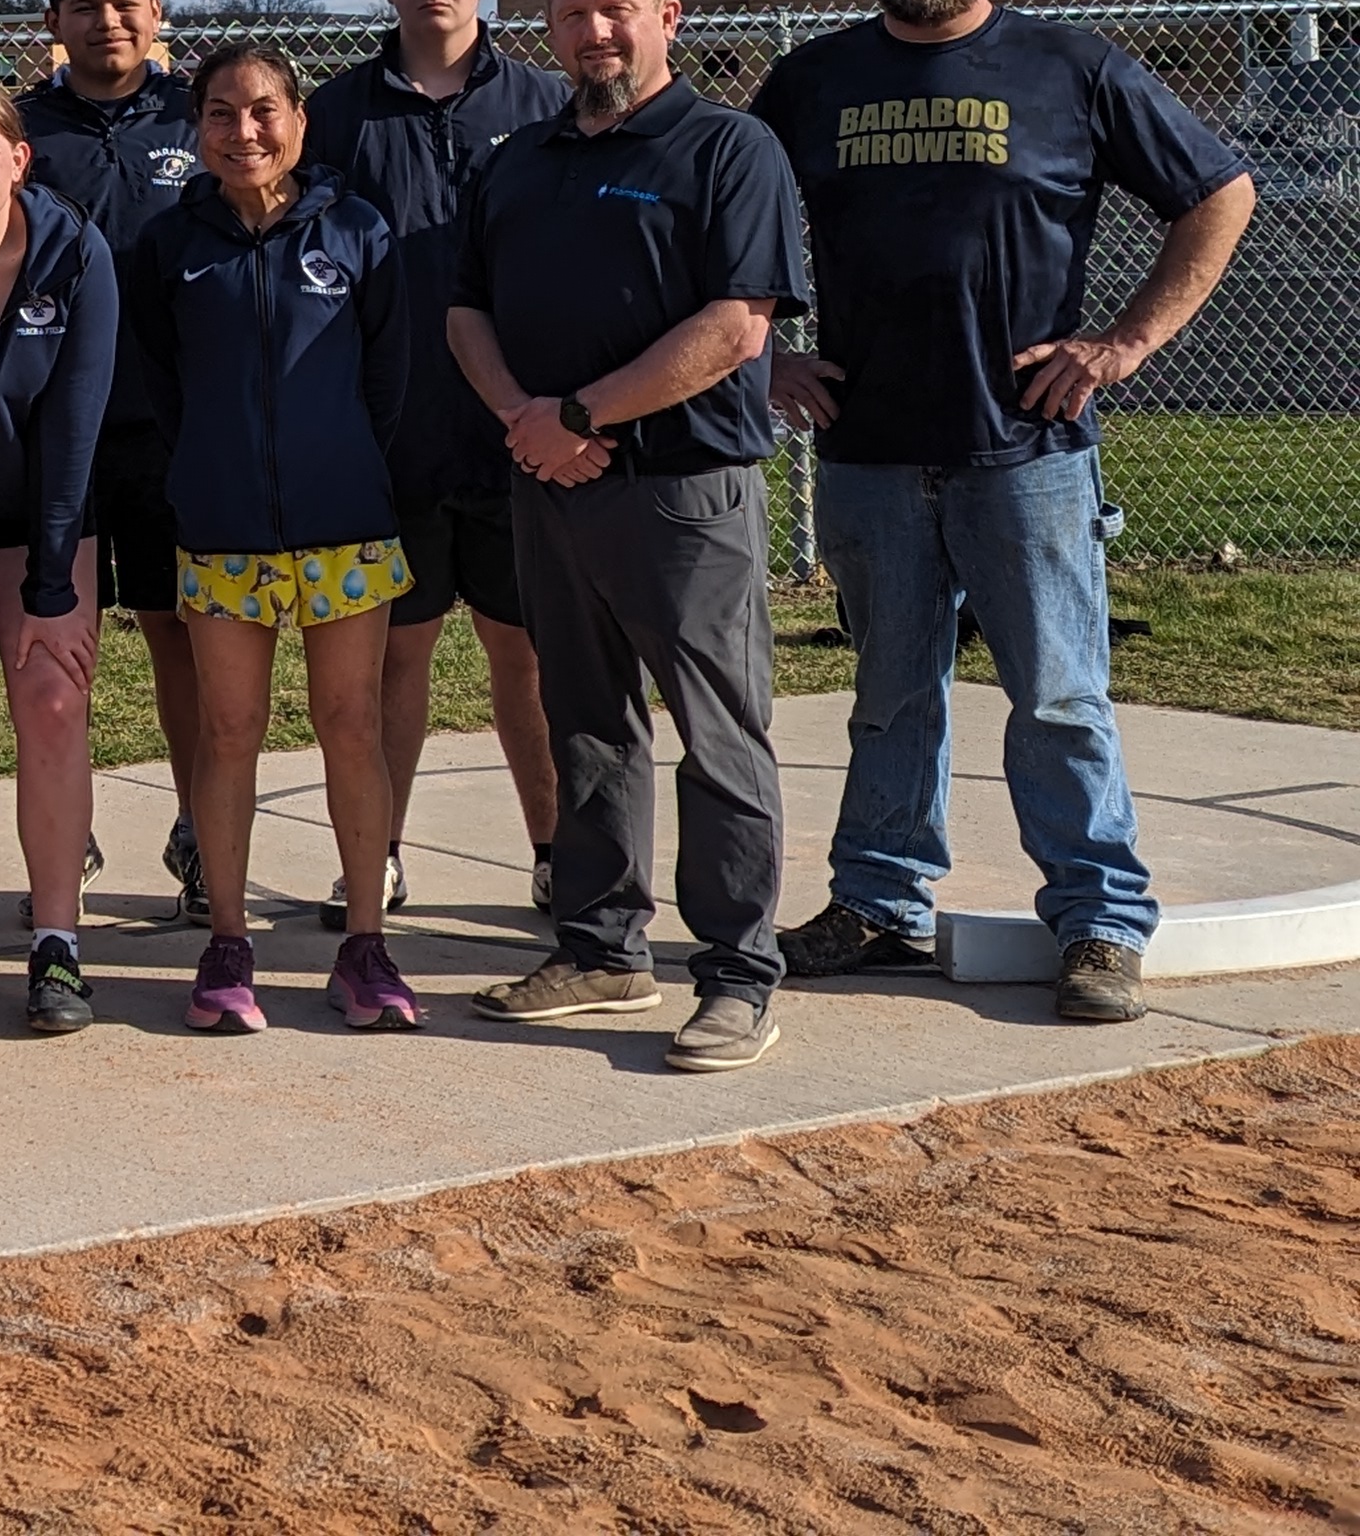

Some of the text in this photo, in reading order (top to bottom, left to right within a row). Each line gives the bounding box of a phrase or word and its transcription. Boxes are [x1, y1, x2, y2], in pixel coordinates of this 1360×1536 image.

[838, 98, 1010, 137] BARABOO
[148, 148, 196, 163] BARABOO
[836, 131, 1008, 169] THROWERS
[44, 964, 84, 992] NIKE
